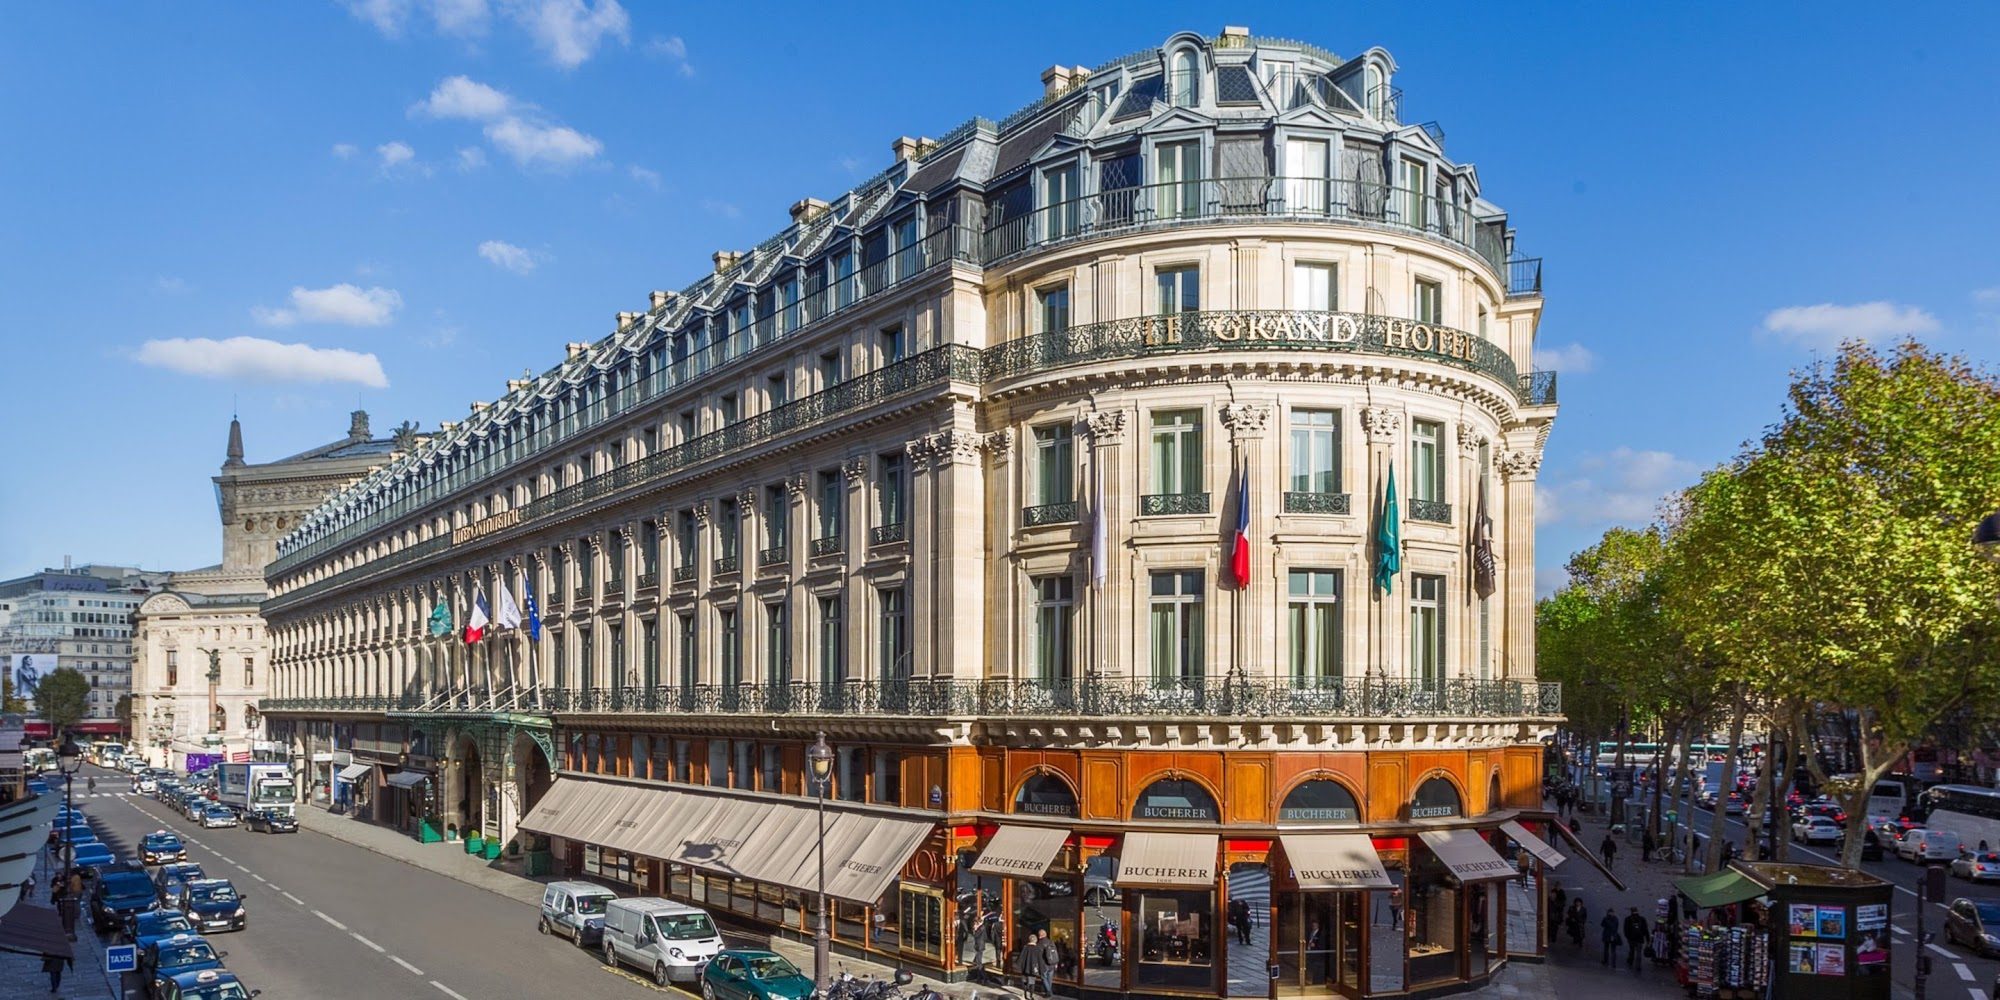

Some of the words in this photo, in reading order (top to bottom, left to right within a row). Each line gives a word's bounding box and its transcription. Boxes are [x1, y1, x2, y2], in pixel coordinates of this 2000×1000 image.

[1143, 316, 1183, 346] LE
[1214, 314, 1358, 343] GRAND
[1384, 319, 1475, 362] HOTEL
[1024, 803, 1071, 815] BUCHERER
[1144, 807, 1207, 818] BUCHERER
[1287, 809, 1347, 820] BUCHERER
[1411, 806, 1452, 818] BUCHERER
[838, 859, 882, 875] BUCHERER
[980, 856, 1044, 871] BUCHERER
[1452, 860, 1508, 873] BUCHERER
[1124, 867, 1208, 878] BUCHERER
[1300, 869, 1383, 880] BUCHERER
[110, 954, 132, 963] TAXIS
